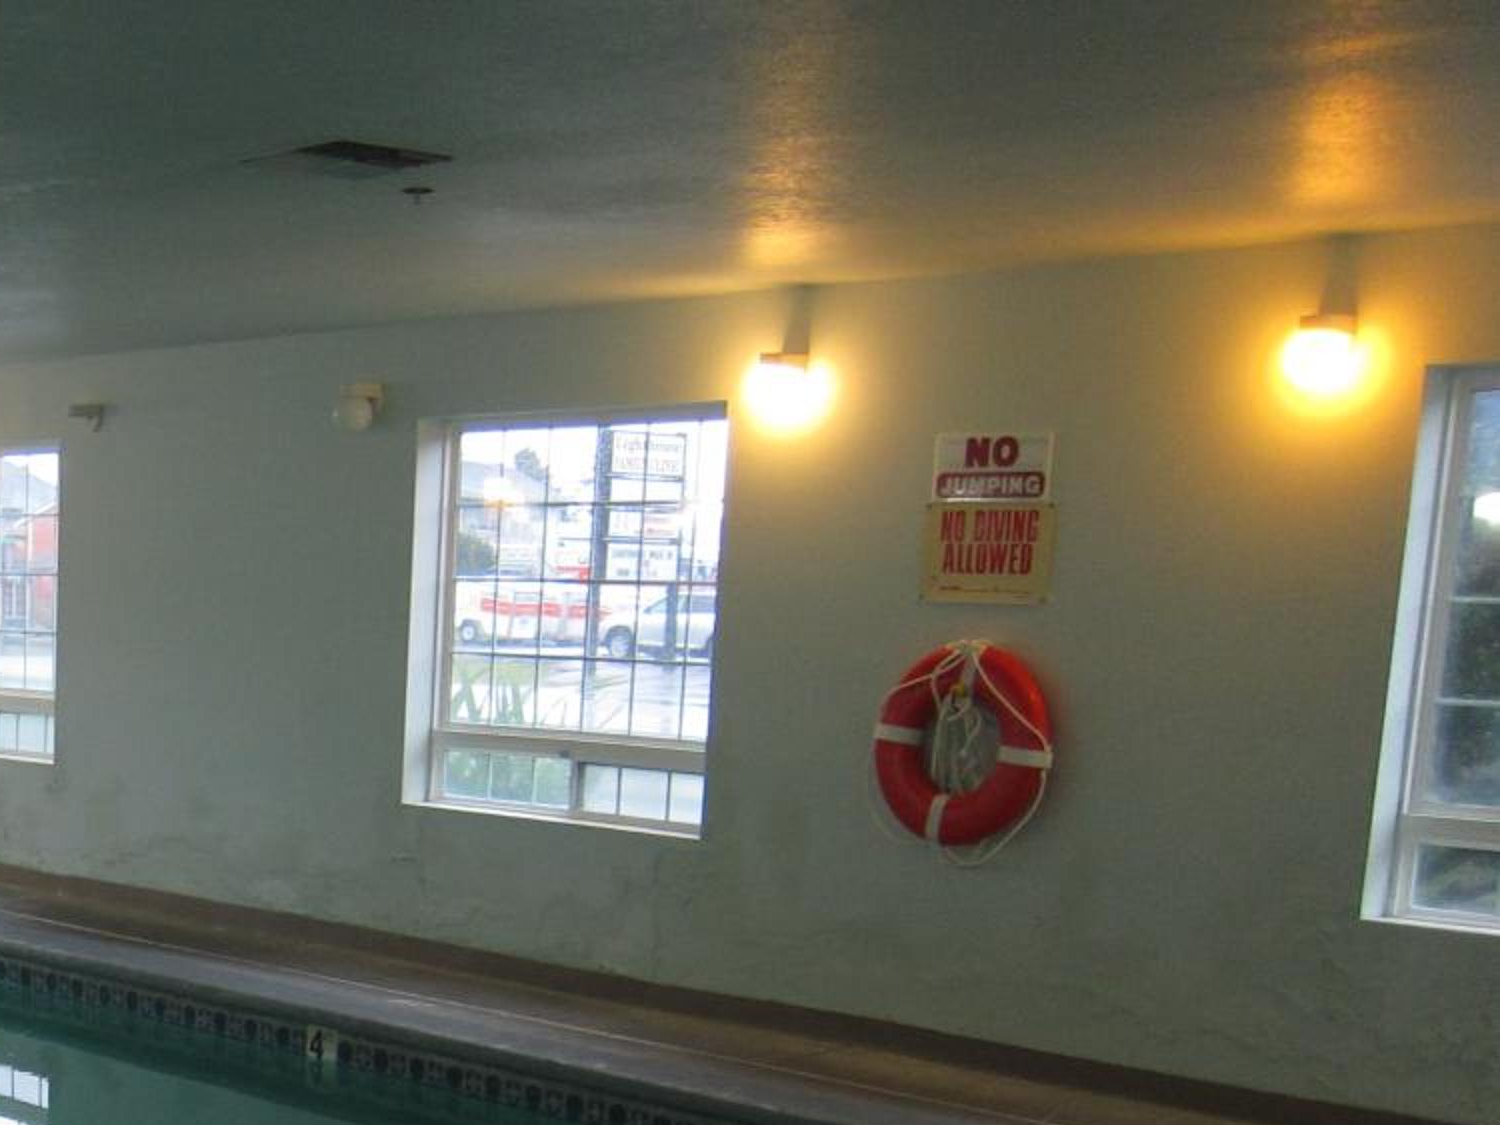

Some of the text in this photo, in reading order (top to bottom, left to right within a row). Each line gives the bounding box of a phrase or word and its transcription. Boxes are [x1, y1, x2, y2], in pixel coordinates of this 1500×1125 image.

[965, 436, 1019, 468] NO
[940, 476, 1041, 496] JUMPING
[940, 510, 1040, 542] NO DIVING
[942, 543, 1033, 575] ALLOWED
[309, 1029, 324, 1060] 4
